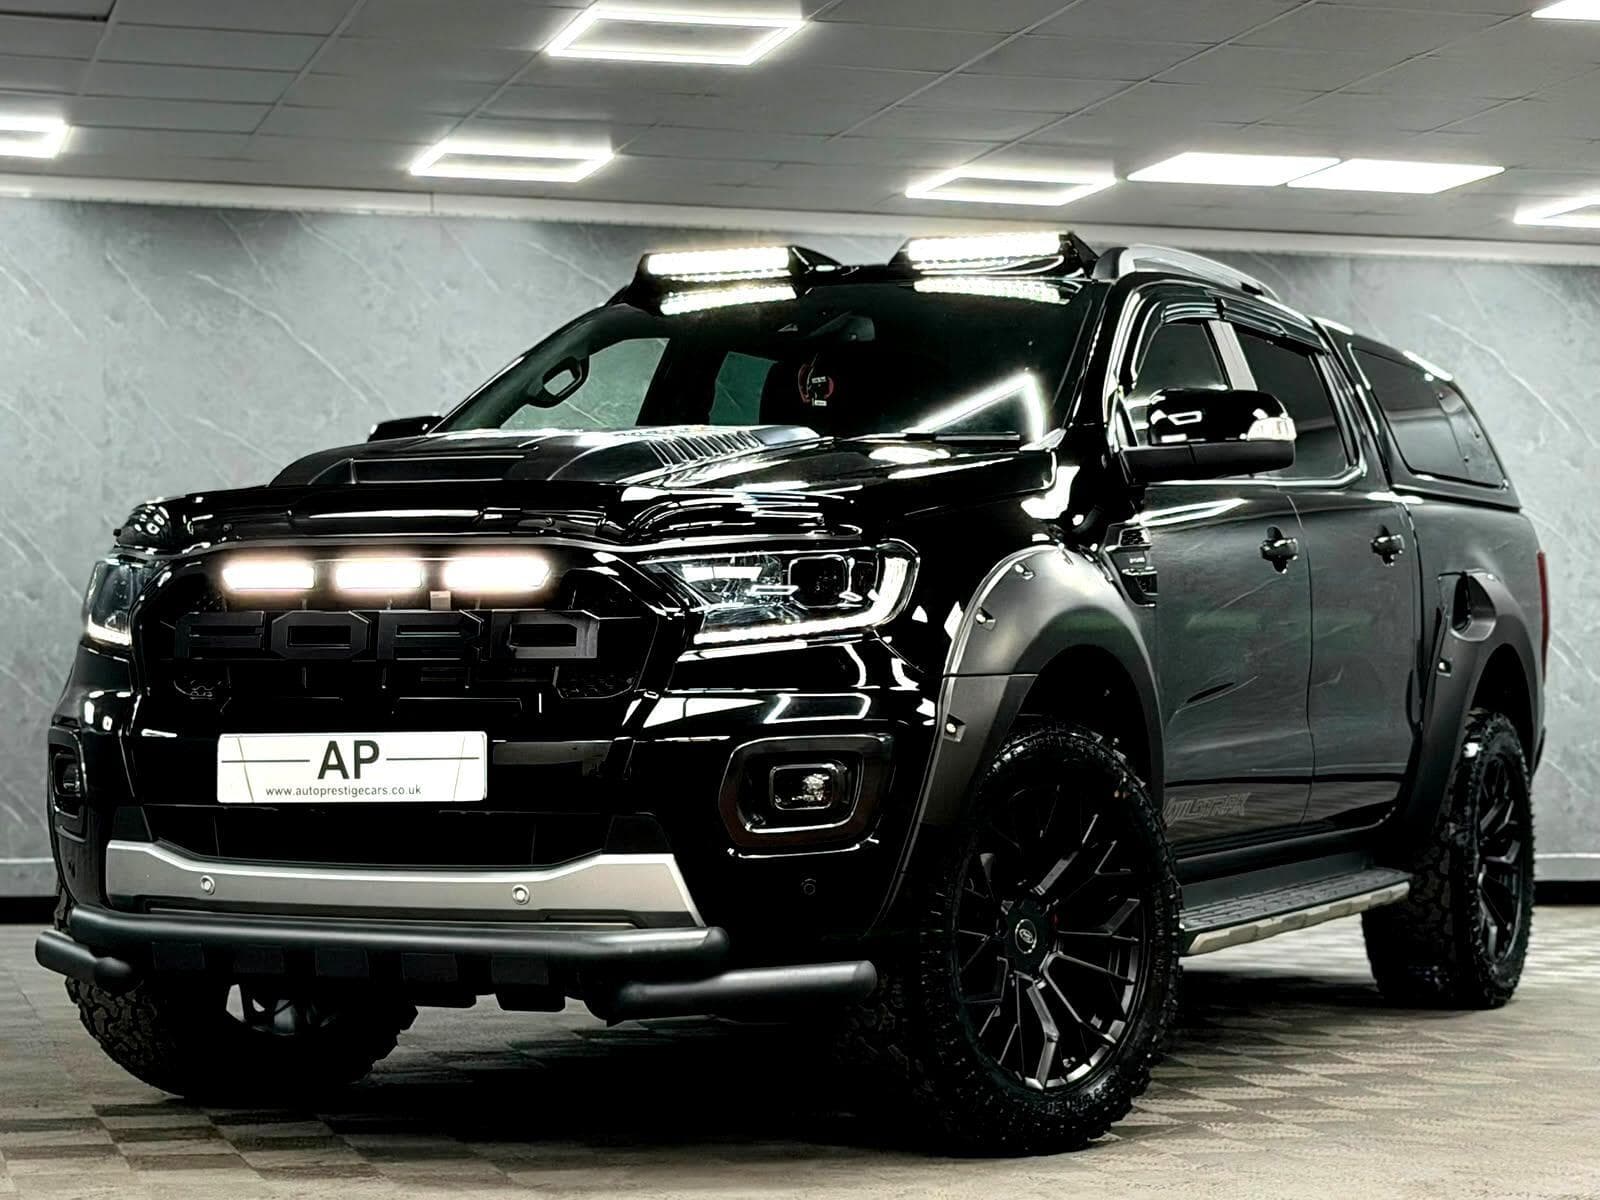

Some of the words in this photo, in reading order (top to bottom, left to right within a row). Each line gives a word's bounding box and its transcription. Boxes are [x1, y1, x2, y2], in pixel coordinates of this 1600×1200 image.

[175, 609, 600, 660] FORD
[317, 739, 381, 780] AP
[265, 784, 422, 798] www.autoprestigecars.co.uk
